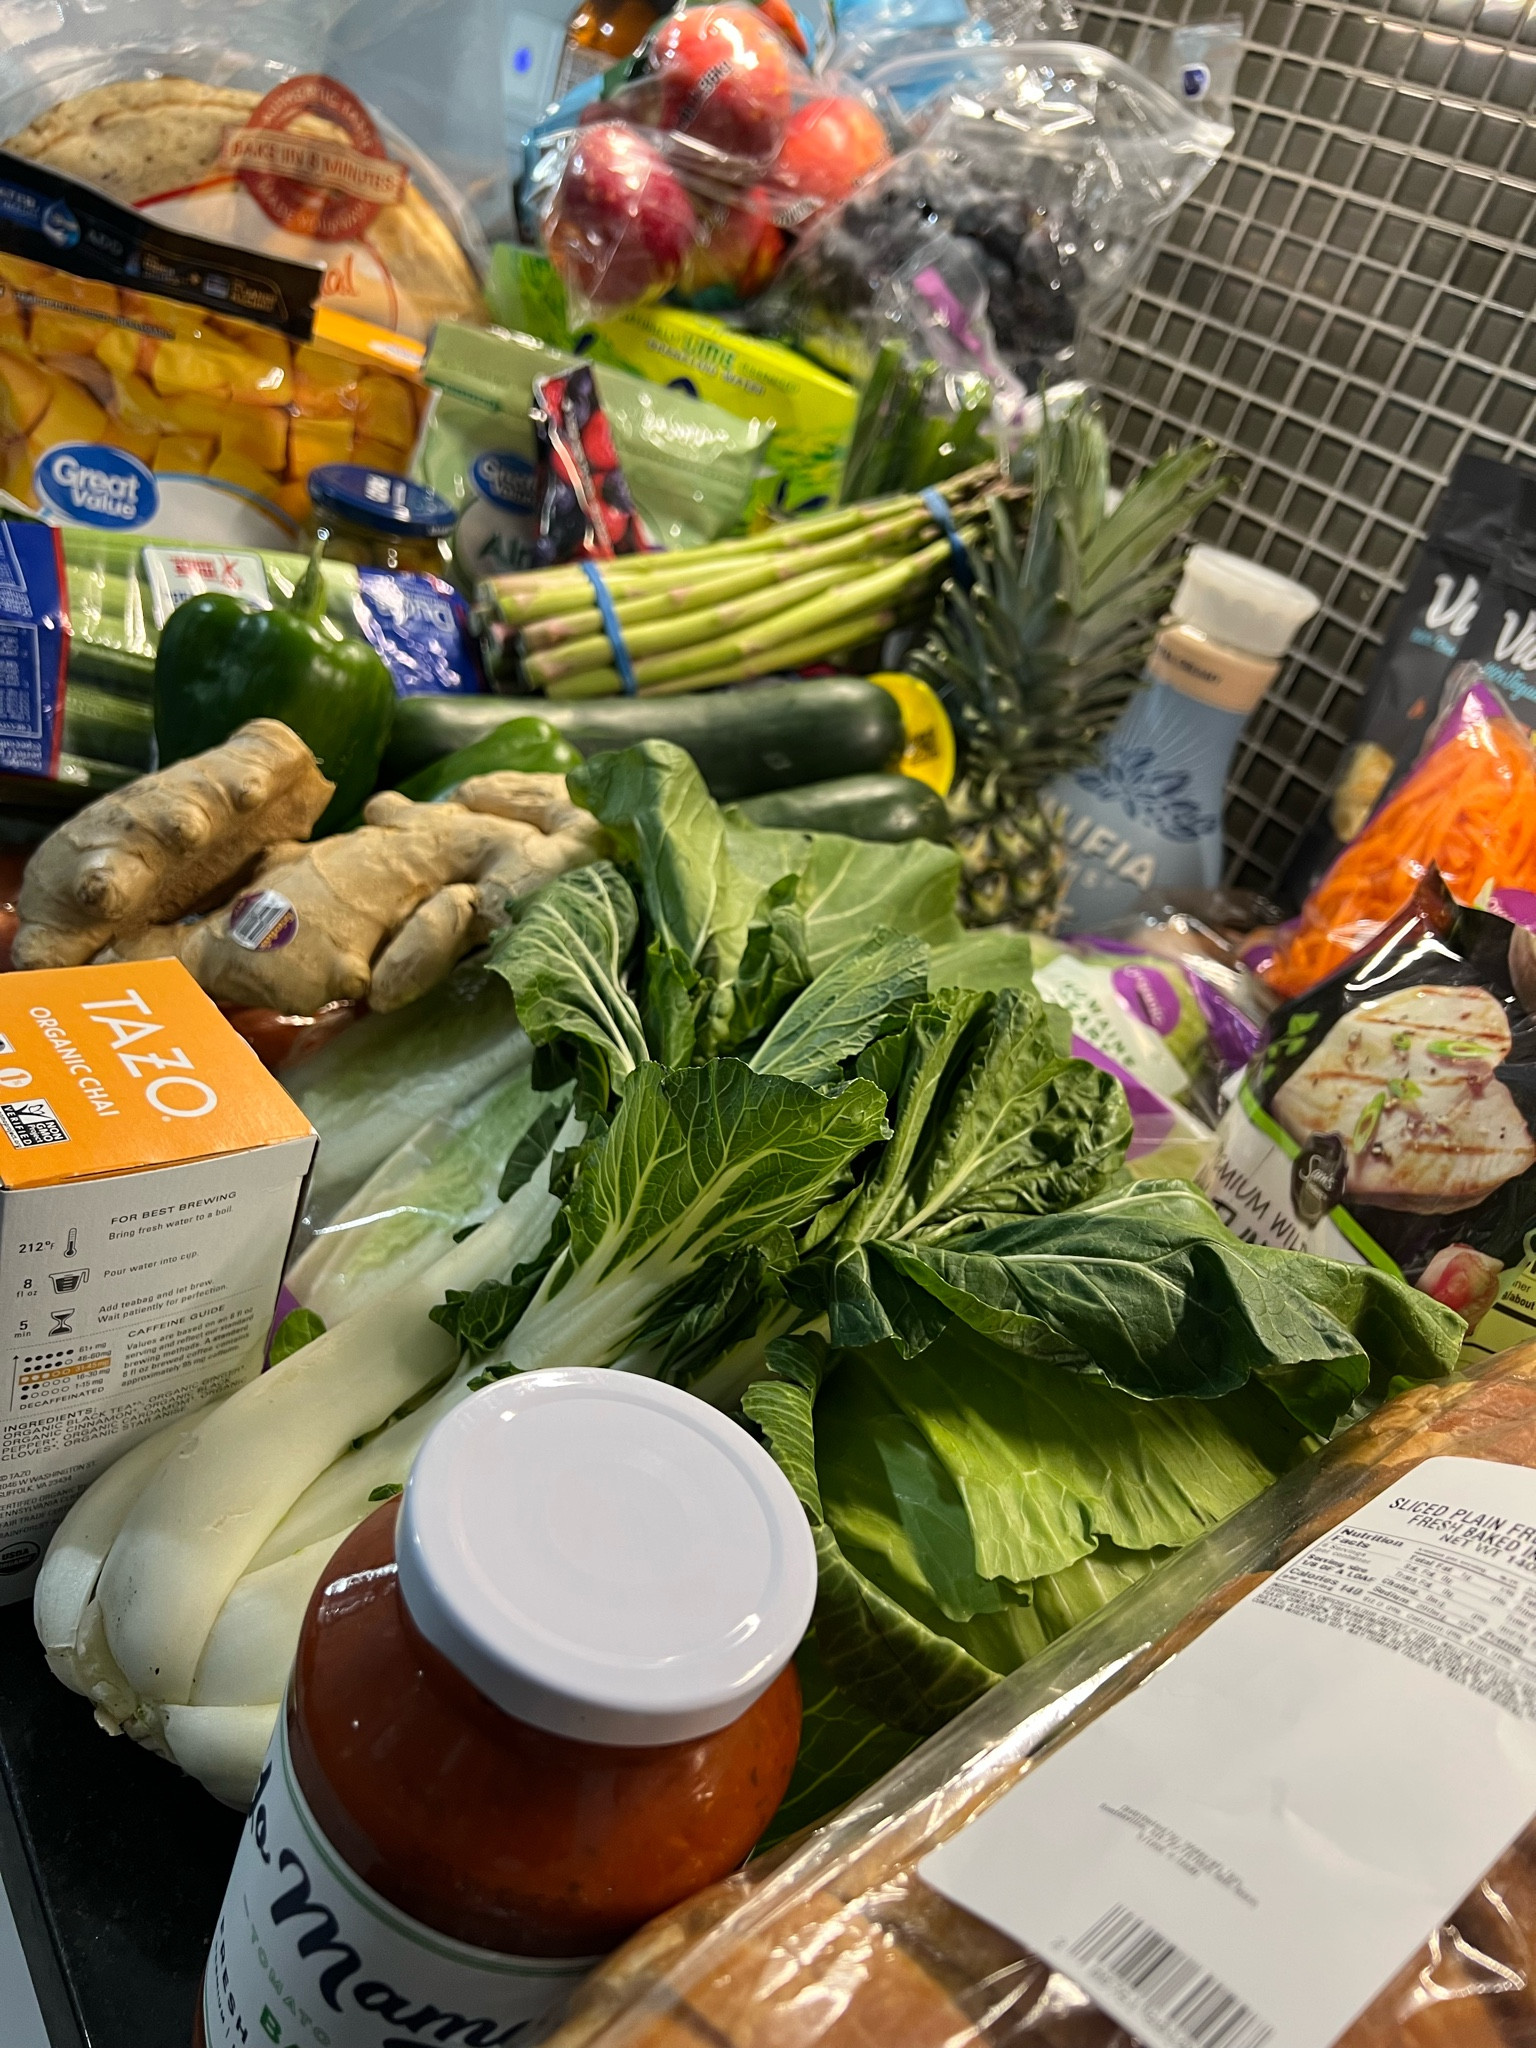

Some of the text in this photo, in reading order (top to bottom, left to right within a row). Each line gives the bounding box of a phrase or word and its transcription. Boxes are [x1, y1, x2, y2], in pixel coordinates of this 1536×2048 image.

[52, 455, 141, 503] Great
[71, 488, 138, 520] Value
[29, 1006, 121, 1117] ORGANIC CHAI
[80, 988, 218, 1118] TAZO
[3, 1105, 33, 1146] VERIFIED
[27, 1123, 44, 1144] Project
[36, 1122, 55, 1143] GMO
[46, 1120, 65, 1141] NON
[1299, 1154, 1337, 1191] Sam's
[111, 1190, 237, 1225] FOR BEST BREWING
[108, 1228, 136, 1241] Bring
[138, 1222, 164, 1235] fresh
[166, 1217, 193, 1229] water
[195, 1212, 205, 1221] to
[207, 1211, 213, 1219] a
[104, 1251, 200, 1278] Pour water into cup.
[16, 1289, 38, 1298] fl oz
[23, 1278, 33, 1290] 8
[98, 1278, 214, 1314] Add teabag and let brew.
[98, 1284, 228, 1324] Wait patiently for perfection.
[19, 1320, 29, 1331] 5
[128, 1304, 226, 1338] CAFFEINE GUIDE
[14, 1330, 31, 1338] min
[127, 1338, 157, 1350] Values
[159, 1333, 175, 1342] are
[177, 1324, 203, 1337] based
[95, 1342, 107, 1351] mg
[124, 1353, 161, 1370] brewing
[204, 1337, 211, 1345] A
[125, 1347, 157, 1361] serving
[159, 1341, 176, 1352] and
[99, 1367, 111, 1376] mg
[121, 1363, 182, 1387] approximately
[139, 1365, 149, 1374] oz
[151, 1353, 185, 1370] brewed
[91, 1378, 104, 1387] mg
[20, 1386, 105, 1410] DECAFFEINATED
[3, 1380, 199, 1441] ORGANIC BLACK ORGANIC
[3, 1430, 61, 1449] ORGANIC
[144, 1391, 191, 1412] ORGANIC
[4, 1407, 97, 1434] INGREDIENTS:
[63, 1422, 119, 1442] ORGANIC
[63, 1428, 119, 1448] ORGANIC
[122, 1416, 151, 1431] STAR
[9, 1470, 32, 1481] TAZO
[36, 1482, 48, 1491] VA
[0, 1496, 38, 1511] ERTIFIED
[0, 1498, 59, 1518] ENNSYLVANIA
[1389, 1497, 1450, 1517] SLICED
[1450, 1507, 1508, 1532] PLAIN
[1332, 1535, 1371, 1549] Facts
[1340, 1527, 1404, 1547] Nutrition
[1407, 1514, 1521, 1552] FRESH BAKED
[2, 1548, 30, 1561] USDA
[1439, 1533, 1502, 1559] NET WT
[1306, 1553, 1368, 1574] Serving size
[1320, 1563, 1333, 1572] OF
[1336, 1567, 1344, 1576] A
[1347, 1569, 1377, 1584] LOAF
[1435, 1562, 1453, 1573] Fat
[1289, 1566, 1363, 1596] Calories 140
[250, 1922, 332, 2047] TOMATO
